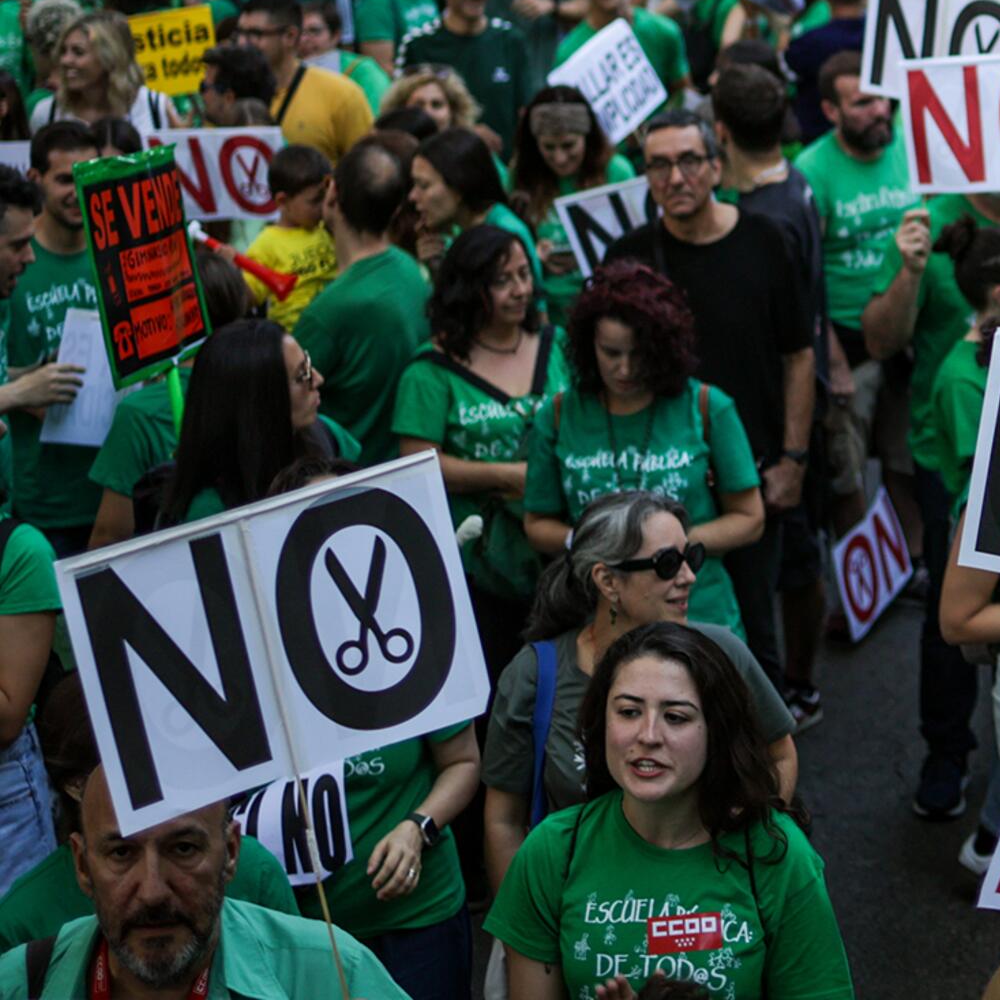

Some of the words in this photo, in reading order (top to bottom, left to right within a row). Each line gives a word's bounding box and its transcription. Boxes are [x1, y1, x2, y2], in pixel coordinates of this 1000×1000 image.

[90, 189, 120, 249] SE
[75, 486, 457, 811] NO
[281, 773, 346, 874] NO
[652, 916, 717, 938] CCOO
